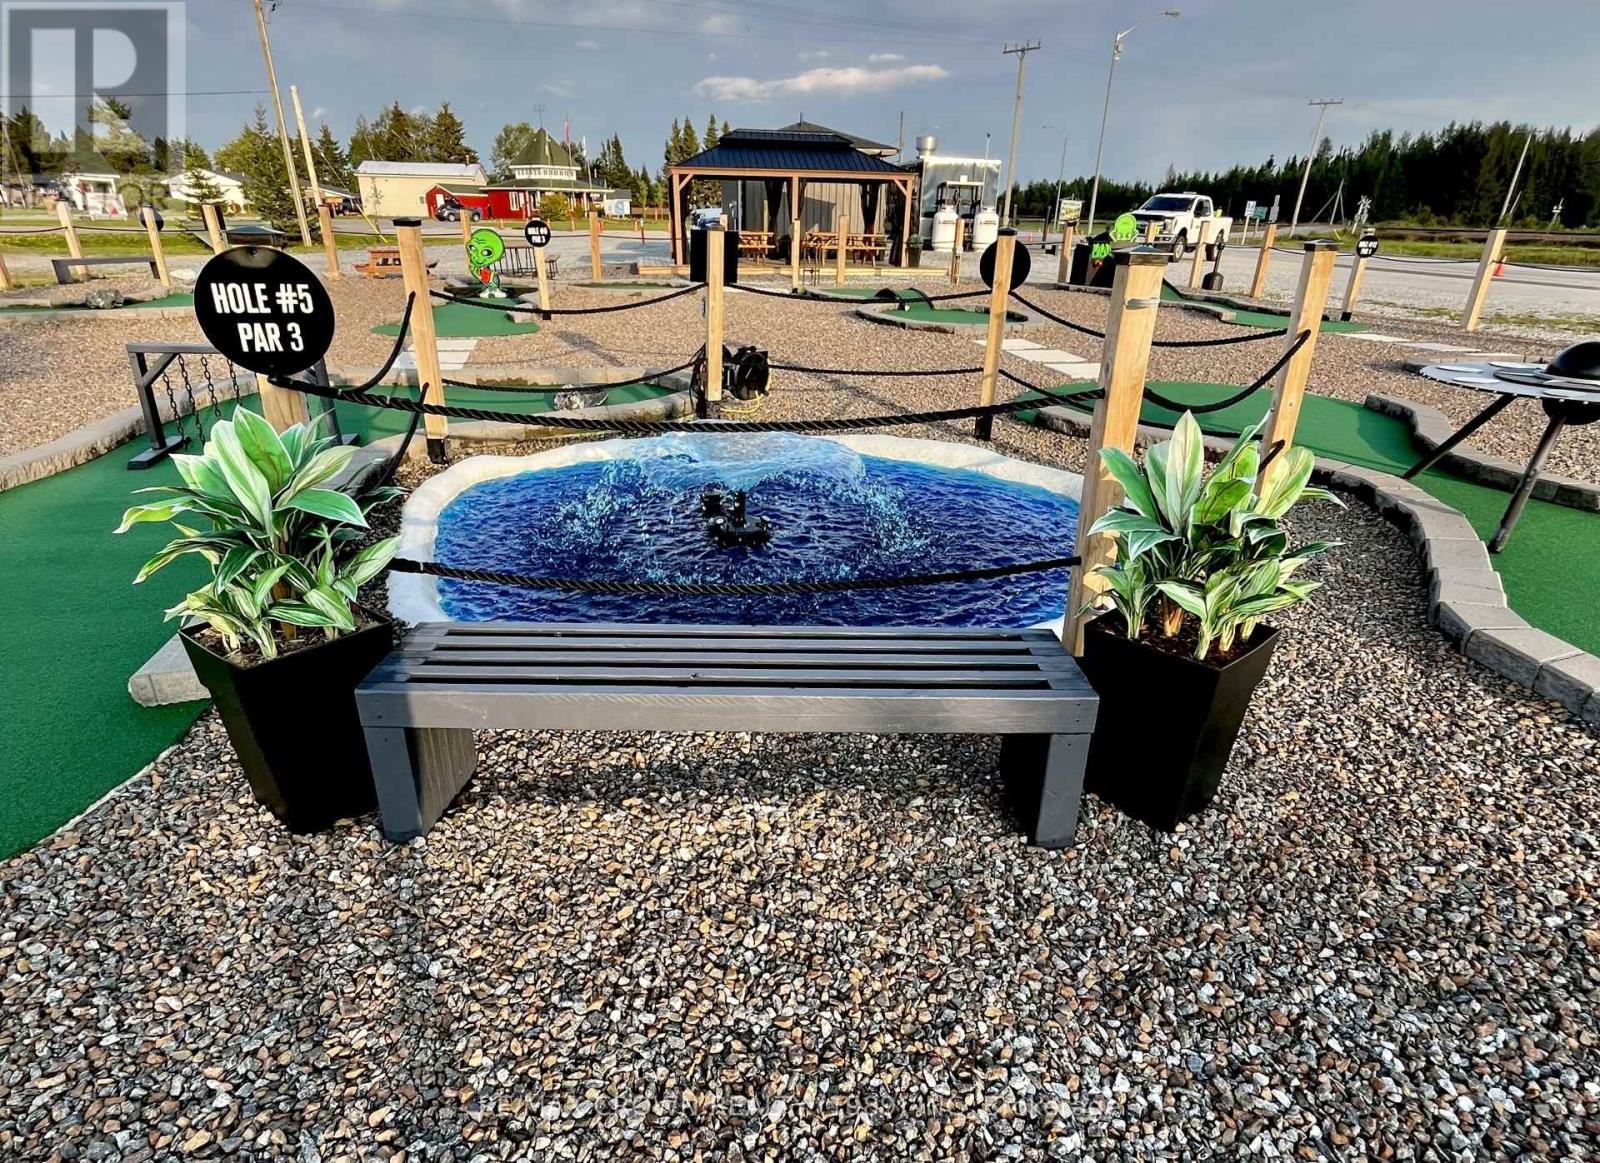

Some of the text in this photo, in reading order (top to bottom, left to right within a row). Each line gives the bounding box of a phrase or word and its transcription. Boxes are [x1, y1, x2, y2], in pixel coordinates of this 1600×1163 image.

[210, 282, 314, 314] HOLE #5
[237, 322, 304, 352] PAR 3
